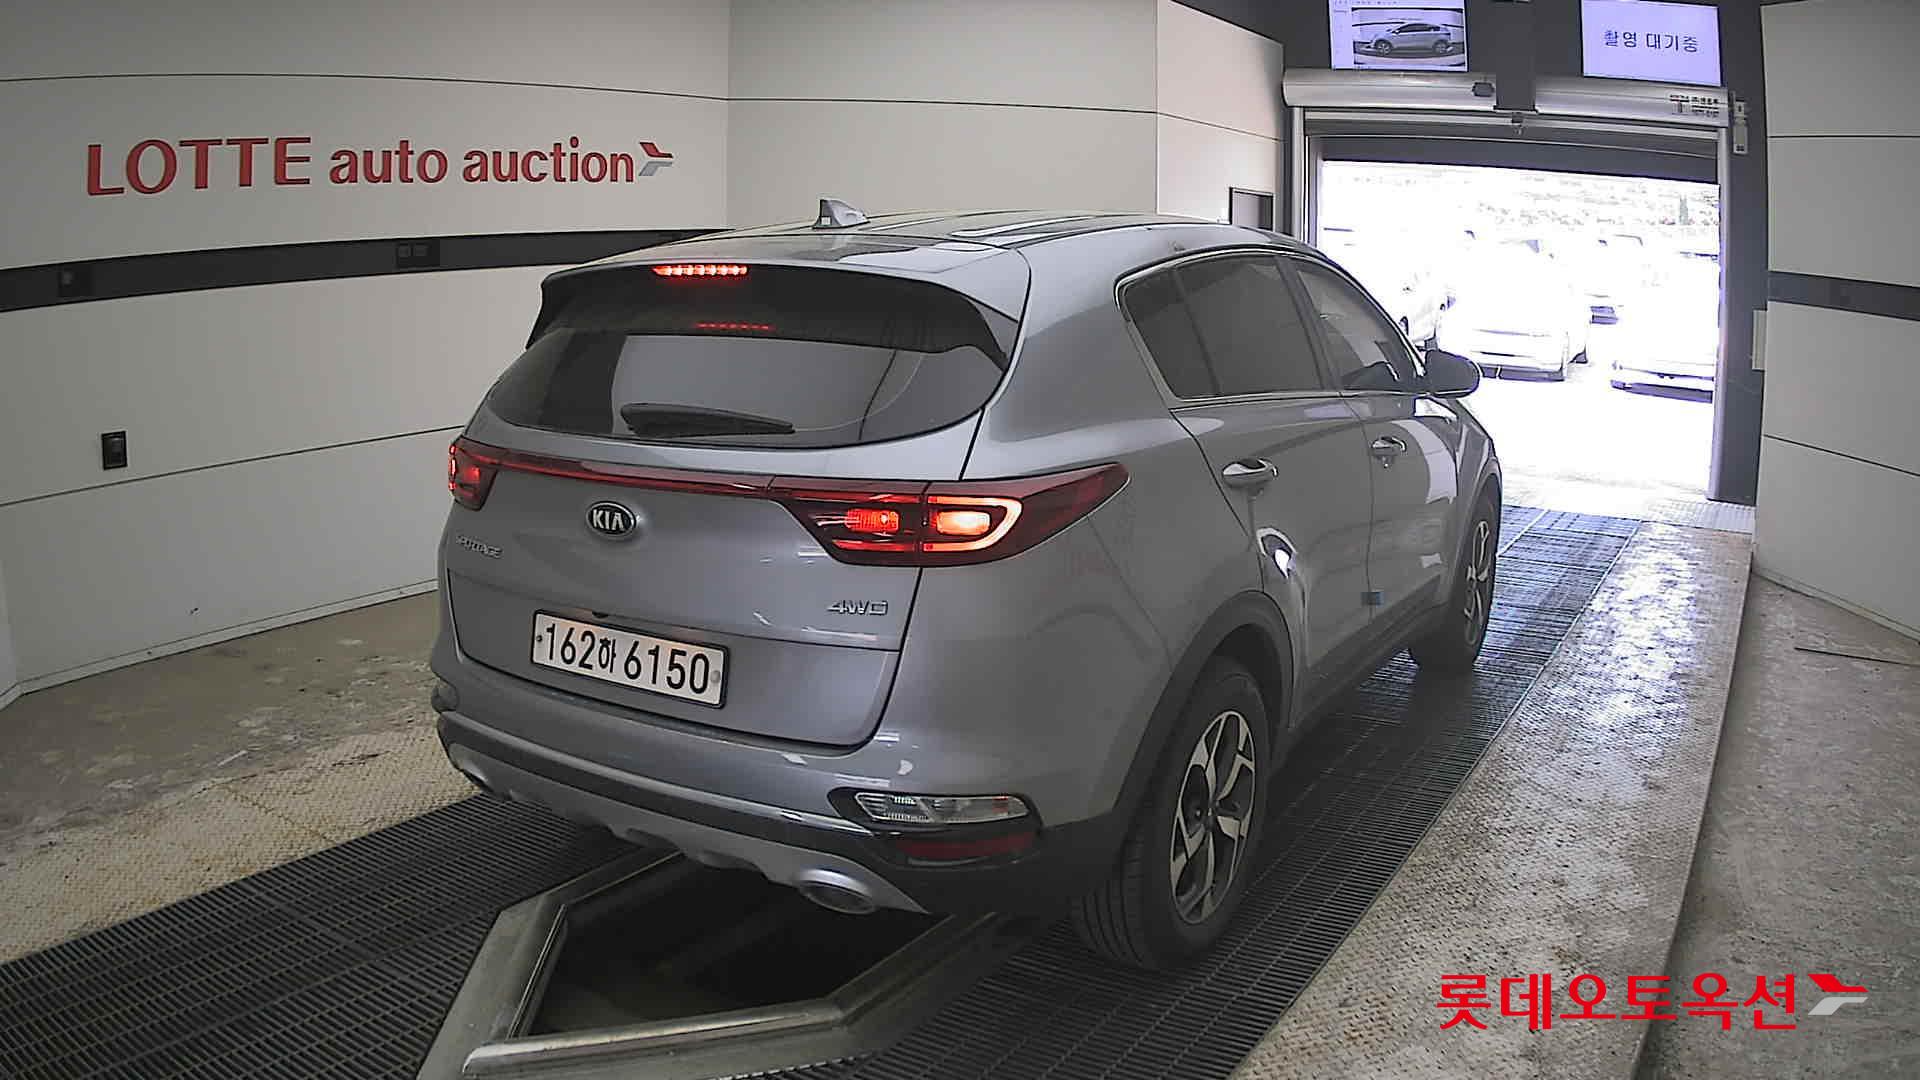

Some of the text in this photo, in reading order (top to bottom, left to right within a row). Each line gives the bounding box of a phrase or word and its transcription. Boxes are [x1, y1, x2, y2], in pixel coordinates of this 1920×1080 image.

[1646, 33, 1698, 53] 대기중
[86, 136, 635, 197] LOTTE auto auction
[592, 509, 624, 531] KIA
